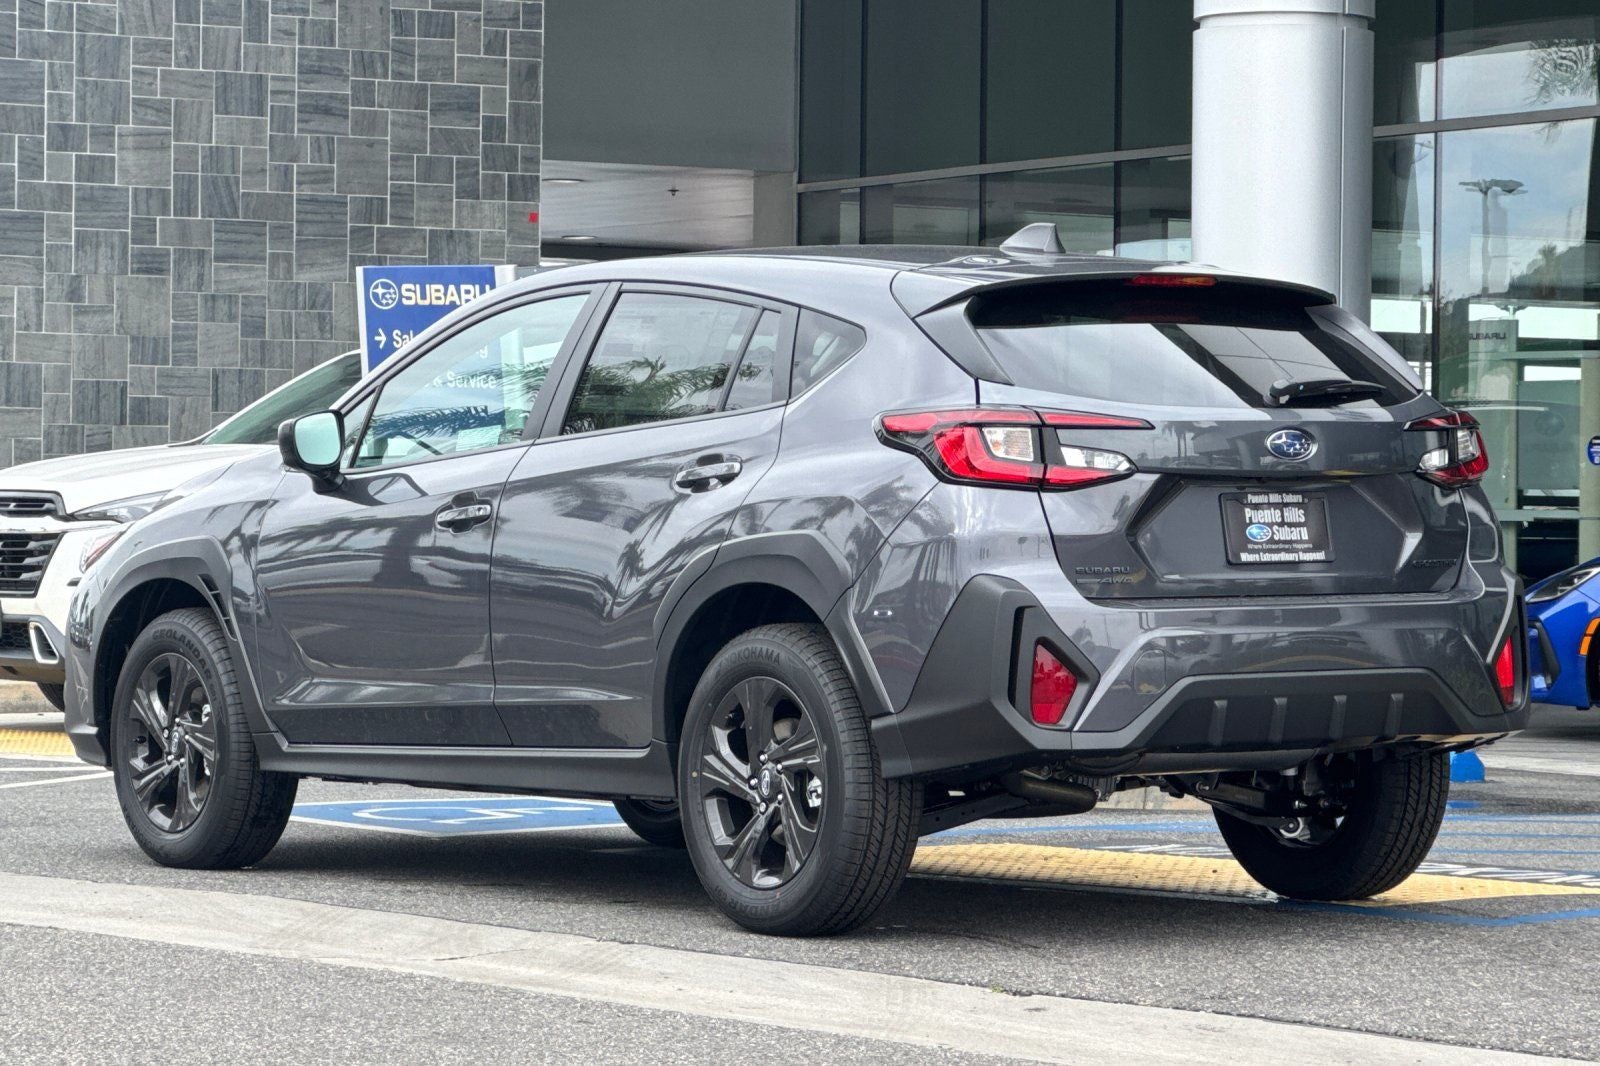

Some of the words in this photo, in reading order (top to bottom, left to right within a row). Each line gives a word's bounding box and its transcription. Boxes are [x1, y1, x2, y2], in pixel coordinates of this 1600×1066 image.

[447, 371, 497, 389] Service
[1247, 494, 1268, 504] Puente
[1269, 493, 1282, 503] Hills
[1283, 494, 1302, 503] Subaru
[1244, 507, 1282, 523] Puente
[1283, 506, 1306, 523] Hills
[1272, 525, 1309, 541] Subaru
[1240, 552, 1260, 562] Where
[1260, 551, 1298, 561] Extraordinary
[1075, 566, 1130, 574] SUBARU
[152, 628, 212, 680] GEOLANDAR
